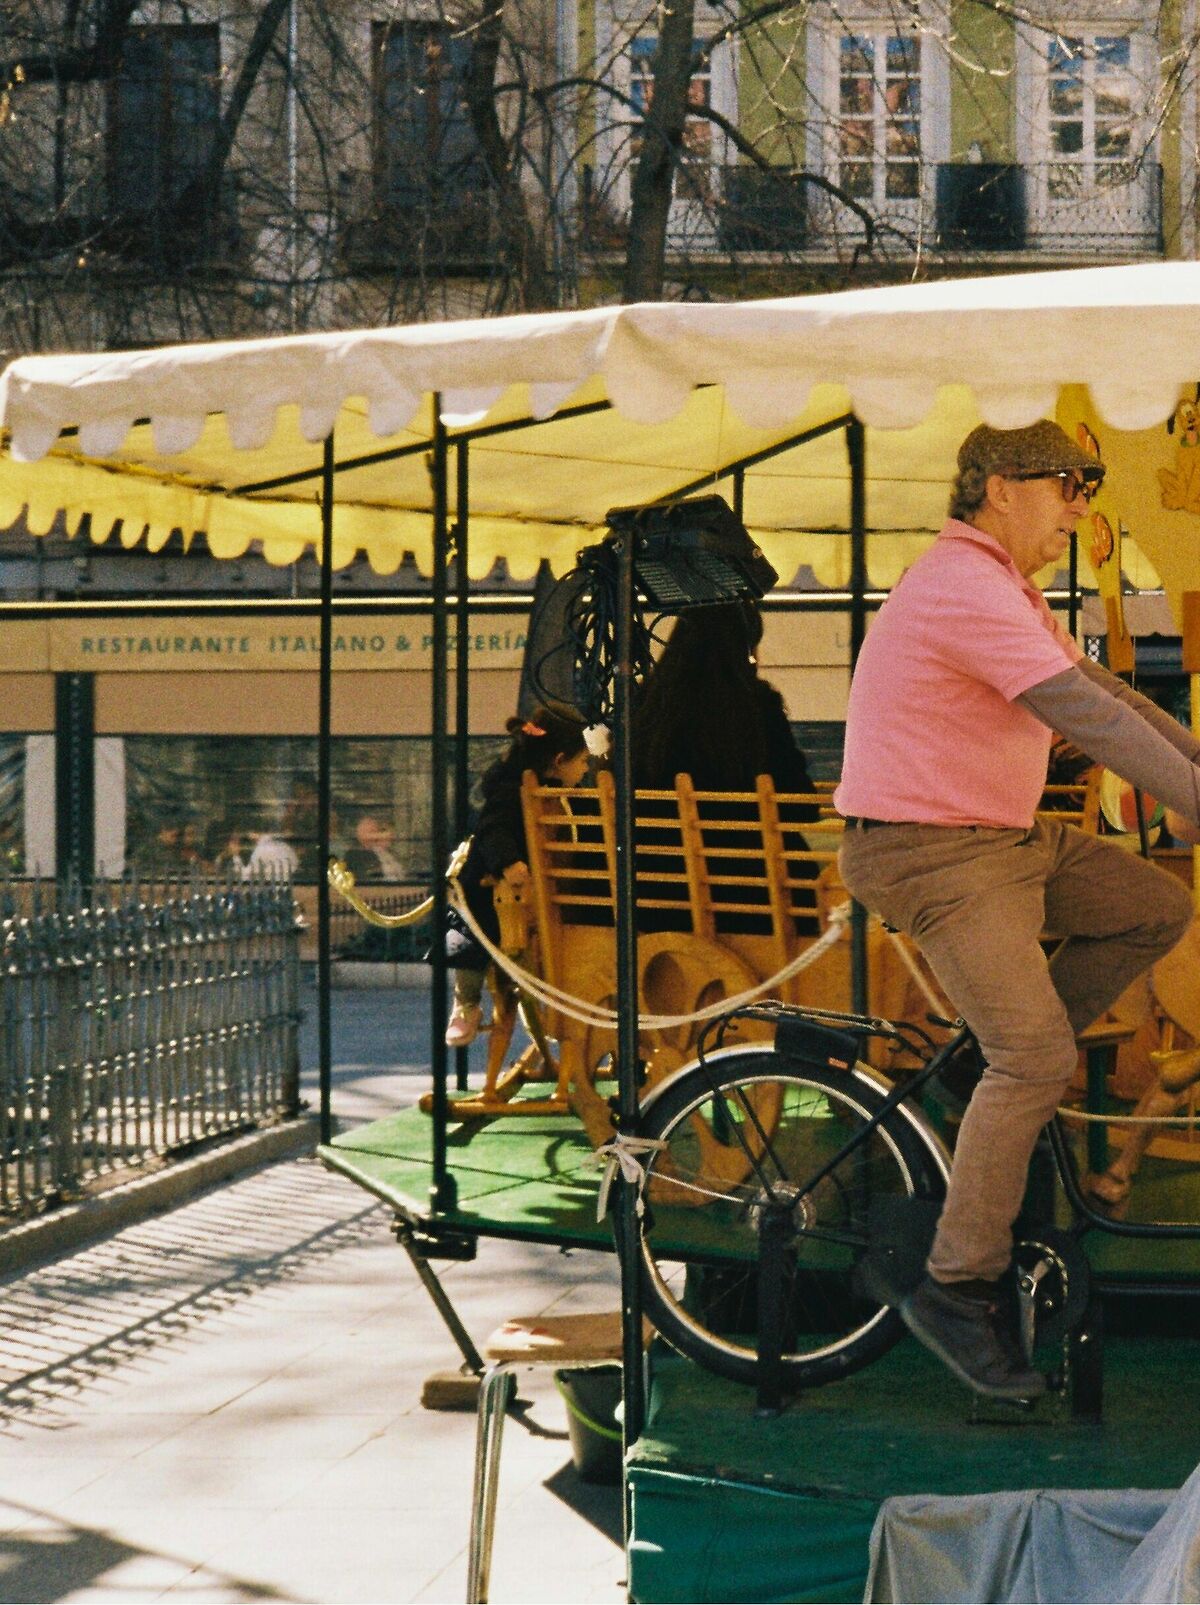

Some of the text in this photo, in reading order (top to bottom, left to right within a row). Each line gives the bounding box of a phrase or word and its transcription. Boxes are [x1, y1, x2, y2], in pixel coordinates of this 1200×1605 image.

[81, 629, 528, 653] RESTAURANTE ITALANO & PZERÍA
